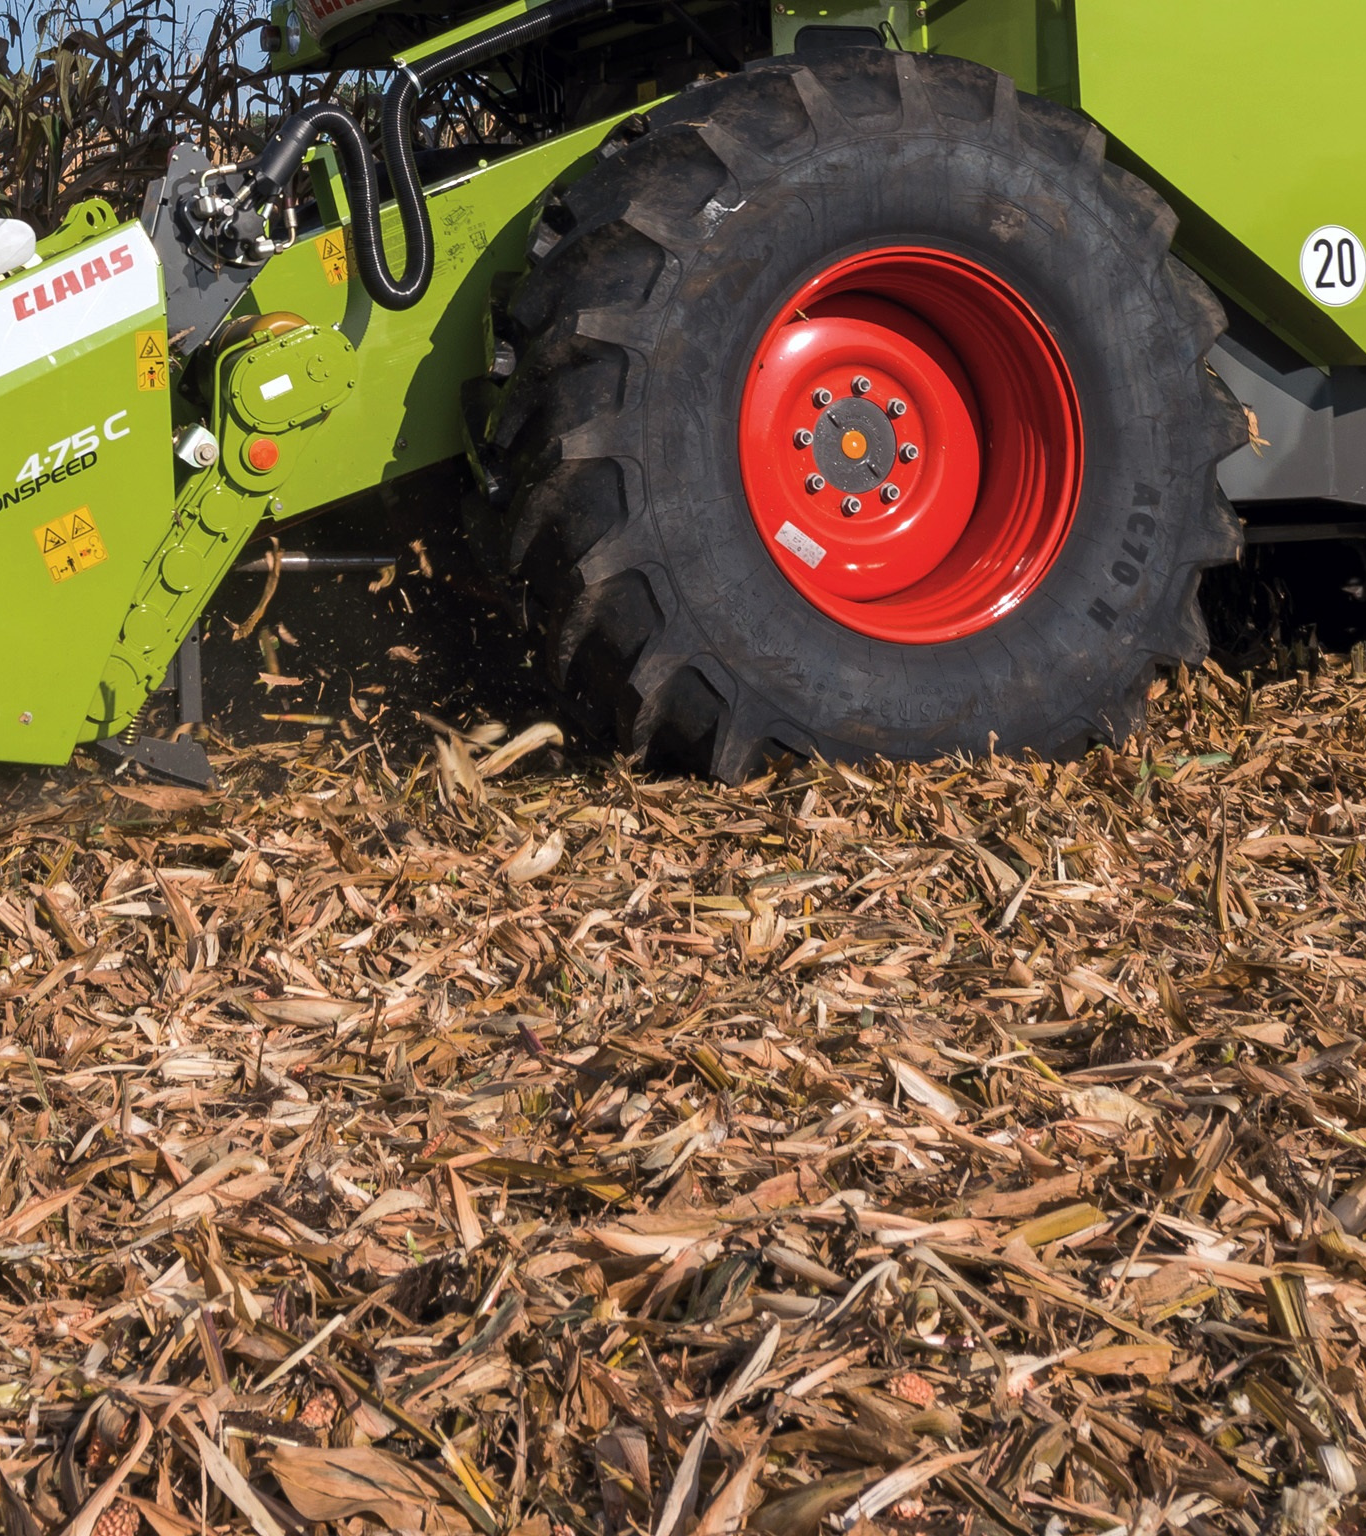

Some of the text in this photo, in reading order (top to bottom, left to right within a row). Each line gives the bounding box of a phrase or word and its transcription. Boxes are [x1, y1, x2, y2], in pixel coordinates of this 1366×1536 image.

[12, 244, 134, 321] CLAAS
[1313, 238, 1356, 288] 20
[103, 410, 130, 441] C
[1087, 482, 1162, 632] AC70 H
